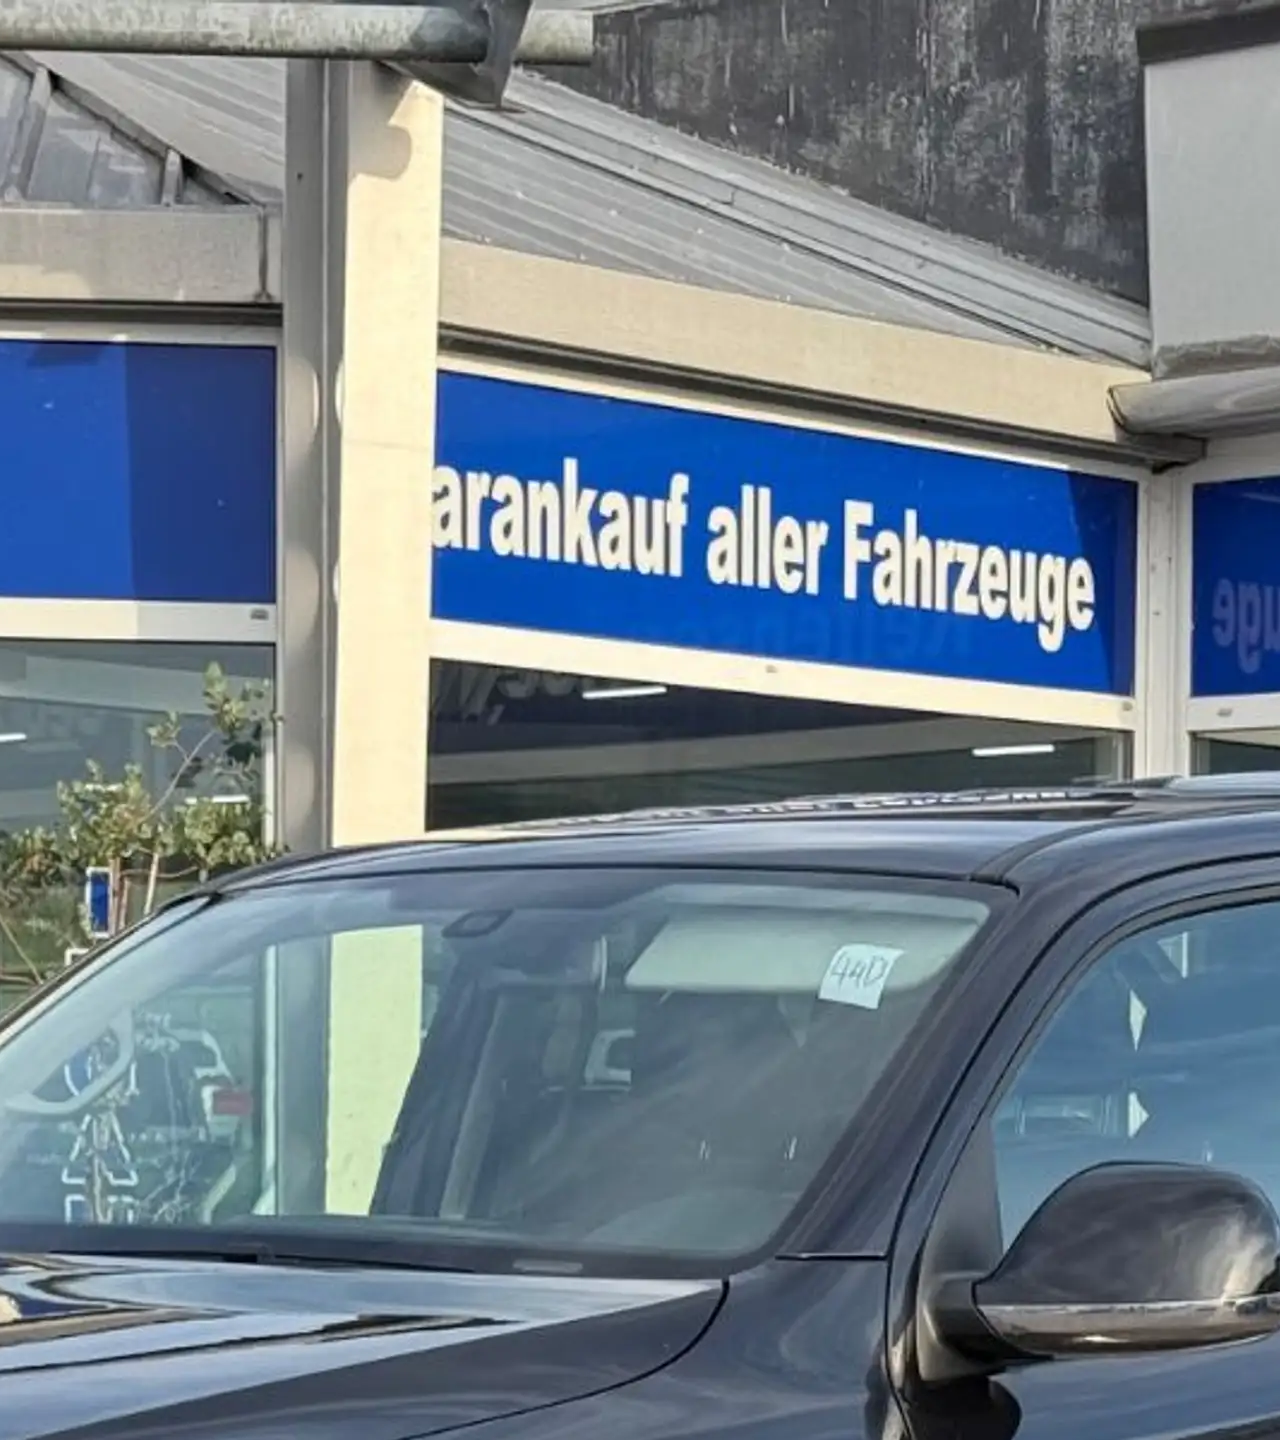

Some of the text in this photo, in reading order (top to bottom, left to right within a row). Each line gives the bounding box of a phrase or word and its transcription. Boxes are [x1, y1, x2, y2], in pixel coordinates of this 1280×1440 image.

[430, 457, 1096, 653] arankauf aller Fahrzeuge
